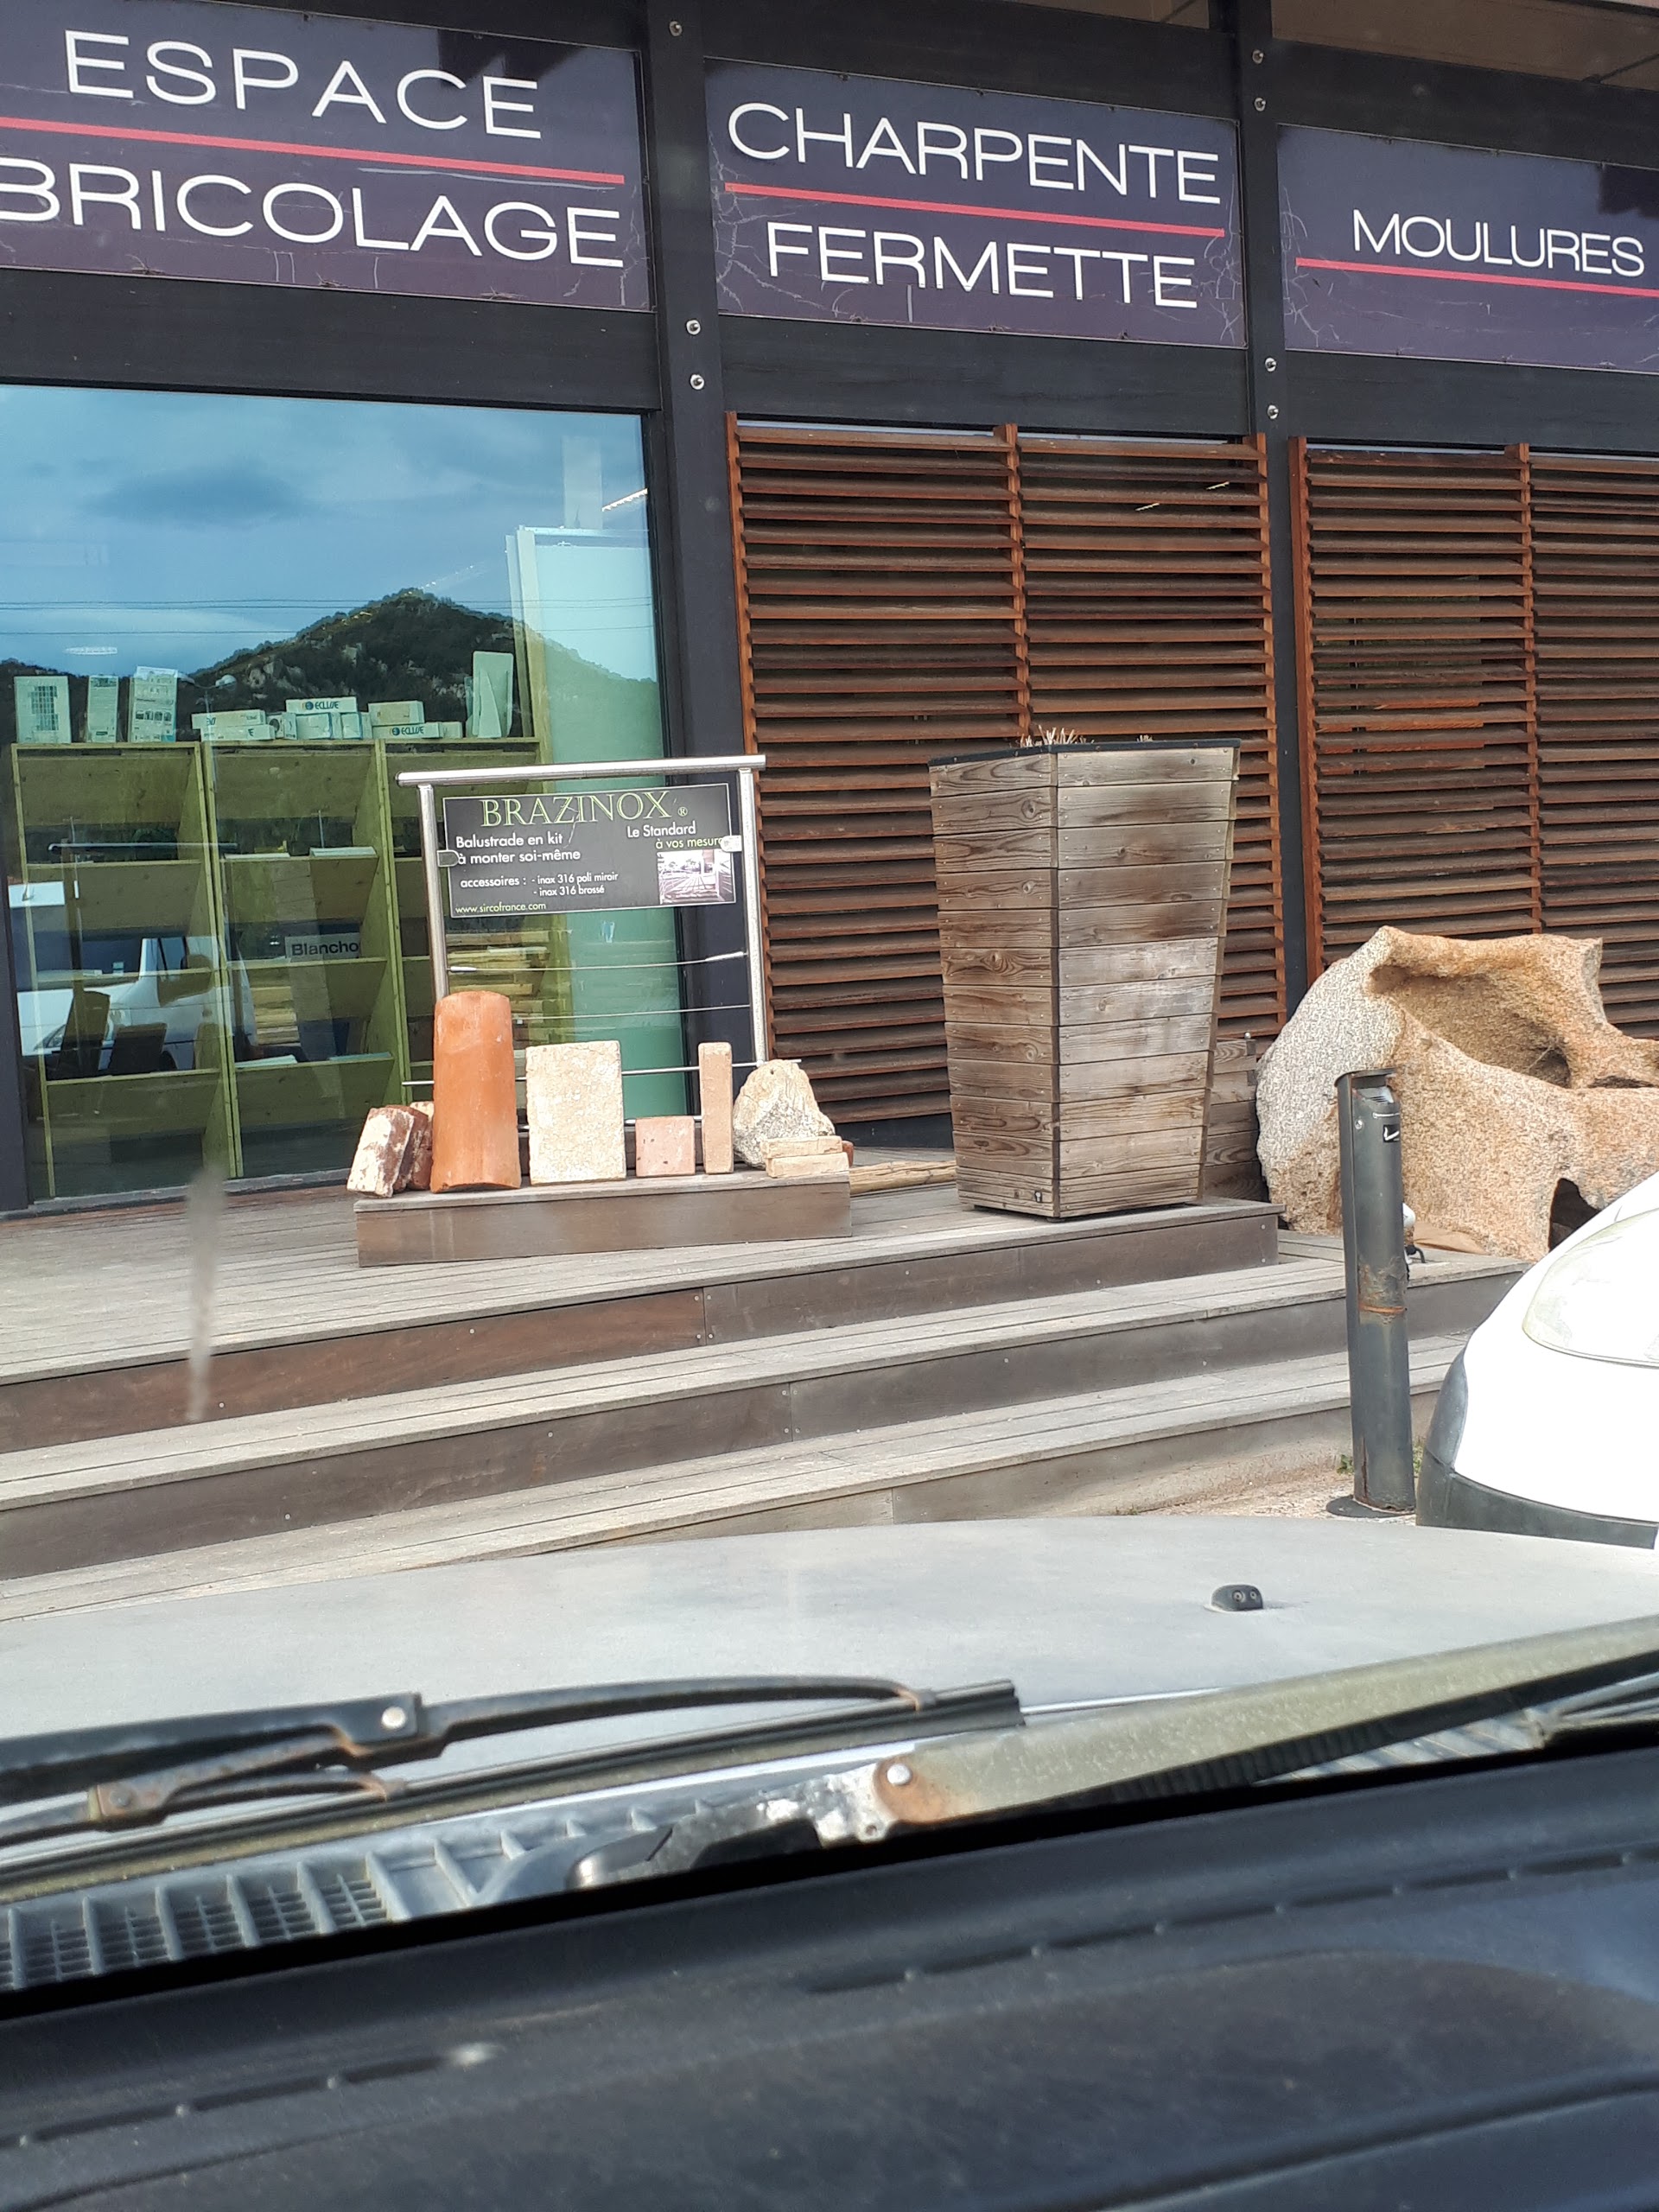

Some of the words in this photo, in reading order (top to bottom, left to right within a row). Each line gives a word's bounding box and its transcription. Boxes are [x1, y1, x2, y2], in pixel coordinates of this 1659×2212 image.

[65, 29, 542, 139] ESPACE
[728, 102, 1221, 206] CHARPENTE
[0, 157, 624, 268] BRICOLAGE
[1351, 209, 1645, 277] MOULURES
[767, 222, 1198, 309] FERMETTE
[480, 791, 672, 826] BRAZINOX
[627, 825, 639, 838] Le
[643, 820, 696, 837] Standard
[456, 833, 524, 849] Balustrade
[528, 836, 543, 845] en
[547, 831, 563, 844] kit
[656, 837, 663, 849] à
[666, 839, 684, 848] vos
[458, 853, 467, 865] à
[470, 851, 515, 864] monter
[518, 849, 581, 861] soi-même
[461, 874, 519, 888] accessoires
[537, 875, 556, 885] inox
[557, 874, 574, 884] 316
[576, 872, 591, 887] poli
[594, 871, 619, 882] miroir
[539, 887, 557, 897] inox
[559, 886, 576, 896] 316
[578, 885, 605, 895] brossé
[455, 902, 546, 913] www.sircofrance.com
[291, 941, 359, 957] Blancho
